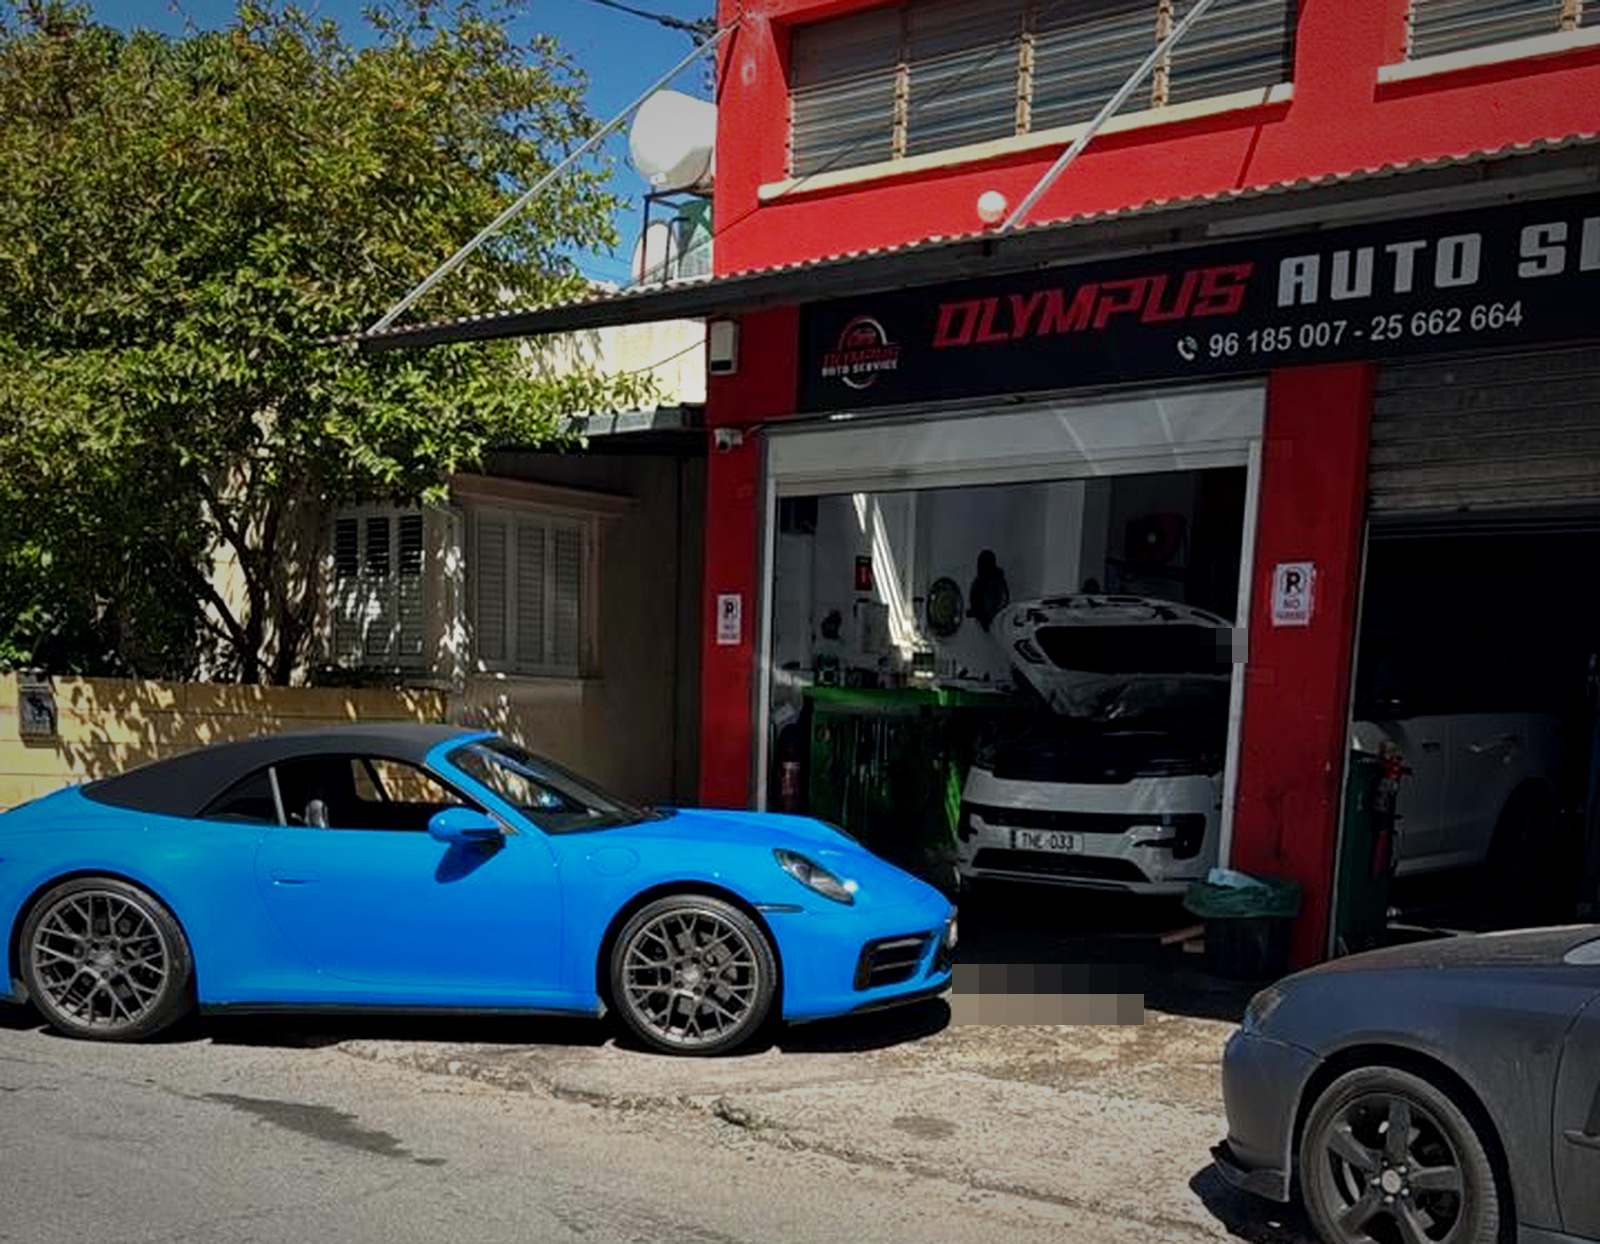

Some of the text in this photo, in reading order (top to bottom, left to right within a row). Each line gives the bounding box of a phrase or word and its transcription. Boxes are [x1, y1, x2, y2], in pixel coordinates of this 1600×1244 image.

[933, 262, 1254, 348] OLYMPUS
[1276, 232, 1482, 308] AUTO
[1209, 332, 1239, 359] 96
[1248, 325, 1292, 355] 185
[1299, 320, 1348, 348] 007
[1370, 315, 1403, 342] 25
[1410, 308, 1461, 336] 662
[1469, 301, 1523, 331] 664
